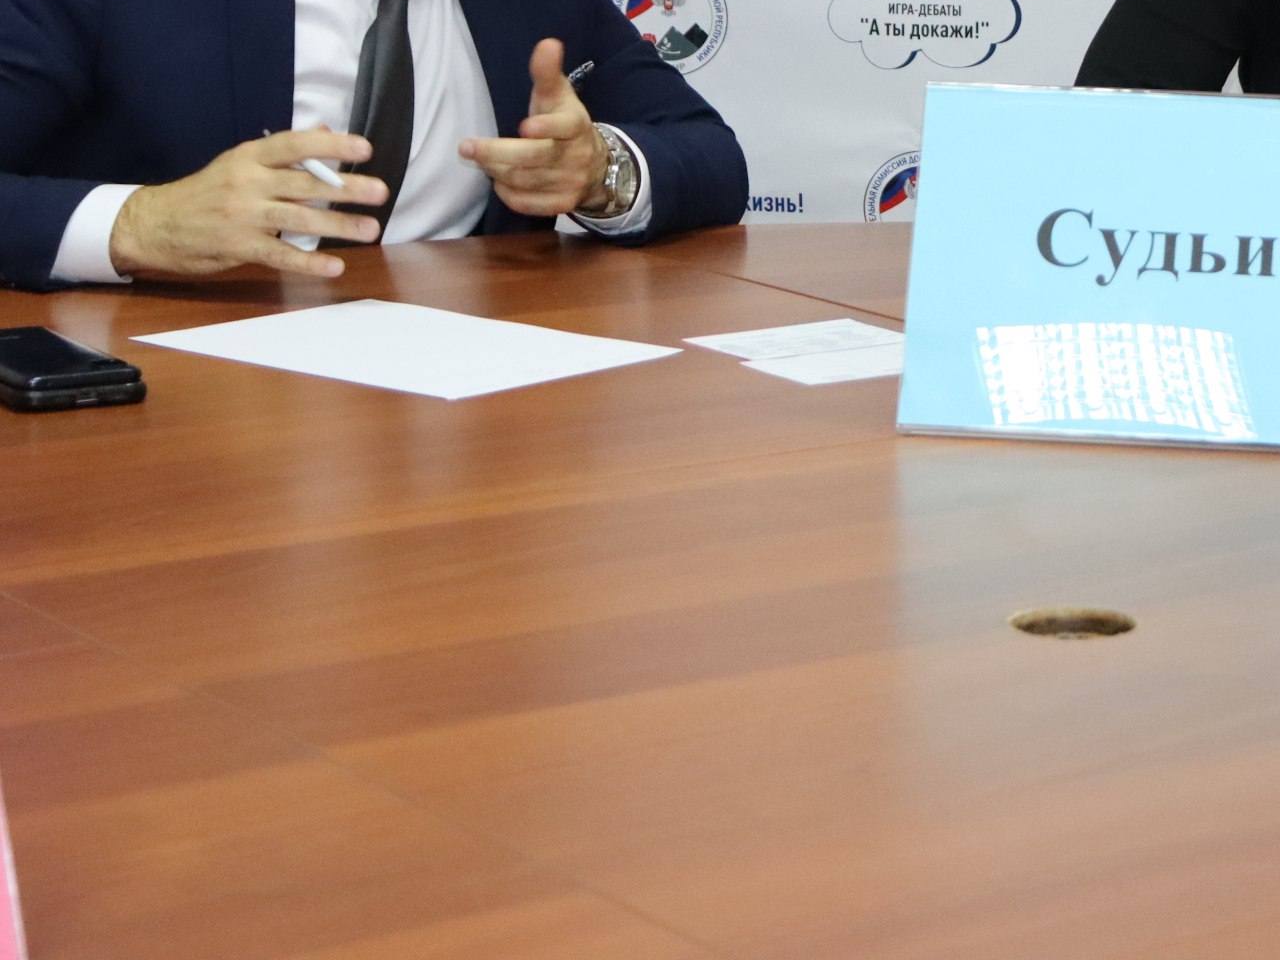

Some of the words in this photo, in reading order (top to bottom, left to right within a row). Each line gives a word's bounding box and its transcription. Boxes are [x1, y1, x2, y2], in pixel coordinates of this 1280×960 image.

[888, 3, 961, 17] ИГРА-ДЕБАТЫ
[697, 15, 723, 61] РЕСПУБЛИКИ
[884, 23, 905, 36] ты
[909, 21, 989, 40] докажи!"
[873, 158, 907, 190] КОМИССИЯ
[1037, 208, 1277, 287] Судьи
